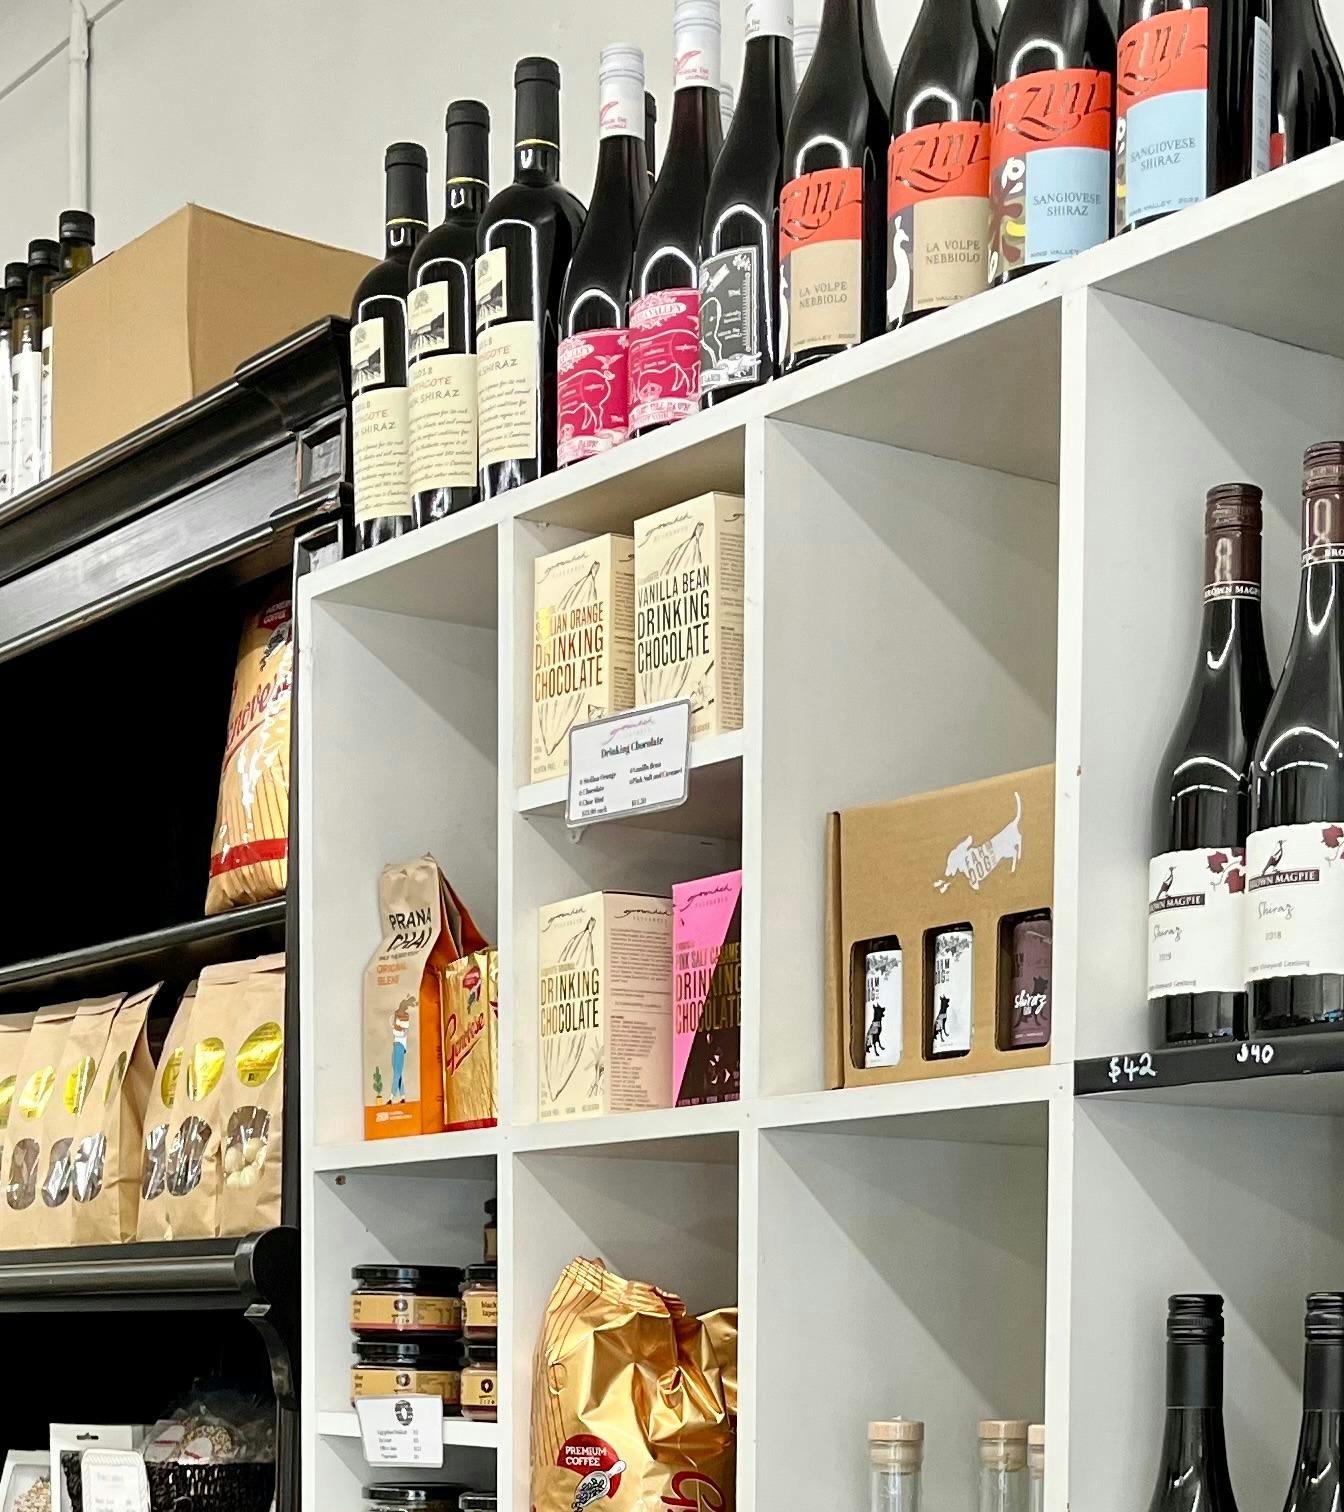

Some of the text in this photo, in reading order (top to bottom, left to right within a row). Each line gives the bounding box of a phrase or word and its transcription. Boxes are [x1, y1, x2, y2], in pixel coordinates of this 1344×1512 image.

[1130, 137, 1196, 163] SANGIOVESE
[1141, 153, 1180, 171] SHIRAZ
[1034, 193, 1101, 206] SANGIOVESE
[1047, 205, 1089, 218] SHIRAZ
[926, 239, 980, 253] LA VOLPE
[926, 252, 980, 266] NEBBIOLO
[815, 281, 847, 294] VOLPE
[799, 294, 847, 308] NEBBIOLO
[638, 565, 710, 608] VANILLA BEAN
[570, 601, 604, 626] ORANGE
[637, 590, 710, 640] DRINKING
[536, 624, 604, 671] DRINKING
[638, 622, 710, 674] CHOCOLATE
[535, 655, 603, 703] CHOCOLATE
[1275, 869, 1317, 884] MAGPIE
[1165, 893, 1203, 907] MAGPIE
[1258, 900, 1295, 920] Shiraz
[389, 907, 432, 931] PRANA
[387, 927, 432, 952] CHAI
[692, 947, 707, 968] SALT
[541, 968, 599, 1006] DRINKING
[676, 964, 741, 1001] DRINKING
[541, 998, 599, 1038] CHOCOLATE
[1237, 1042, 1274, 1064] $40
[1108, 1052, 1157, 1083] $42
[564, 1445, 607, 1457] PREMIUM
[564, 1456, 601, 1467] COFFEE
